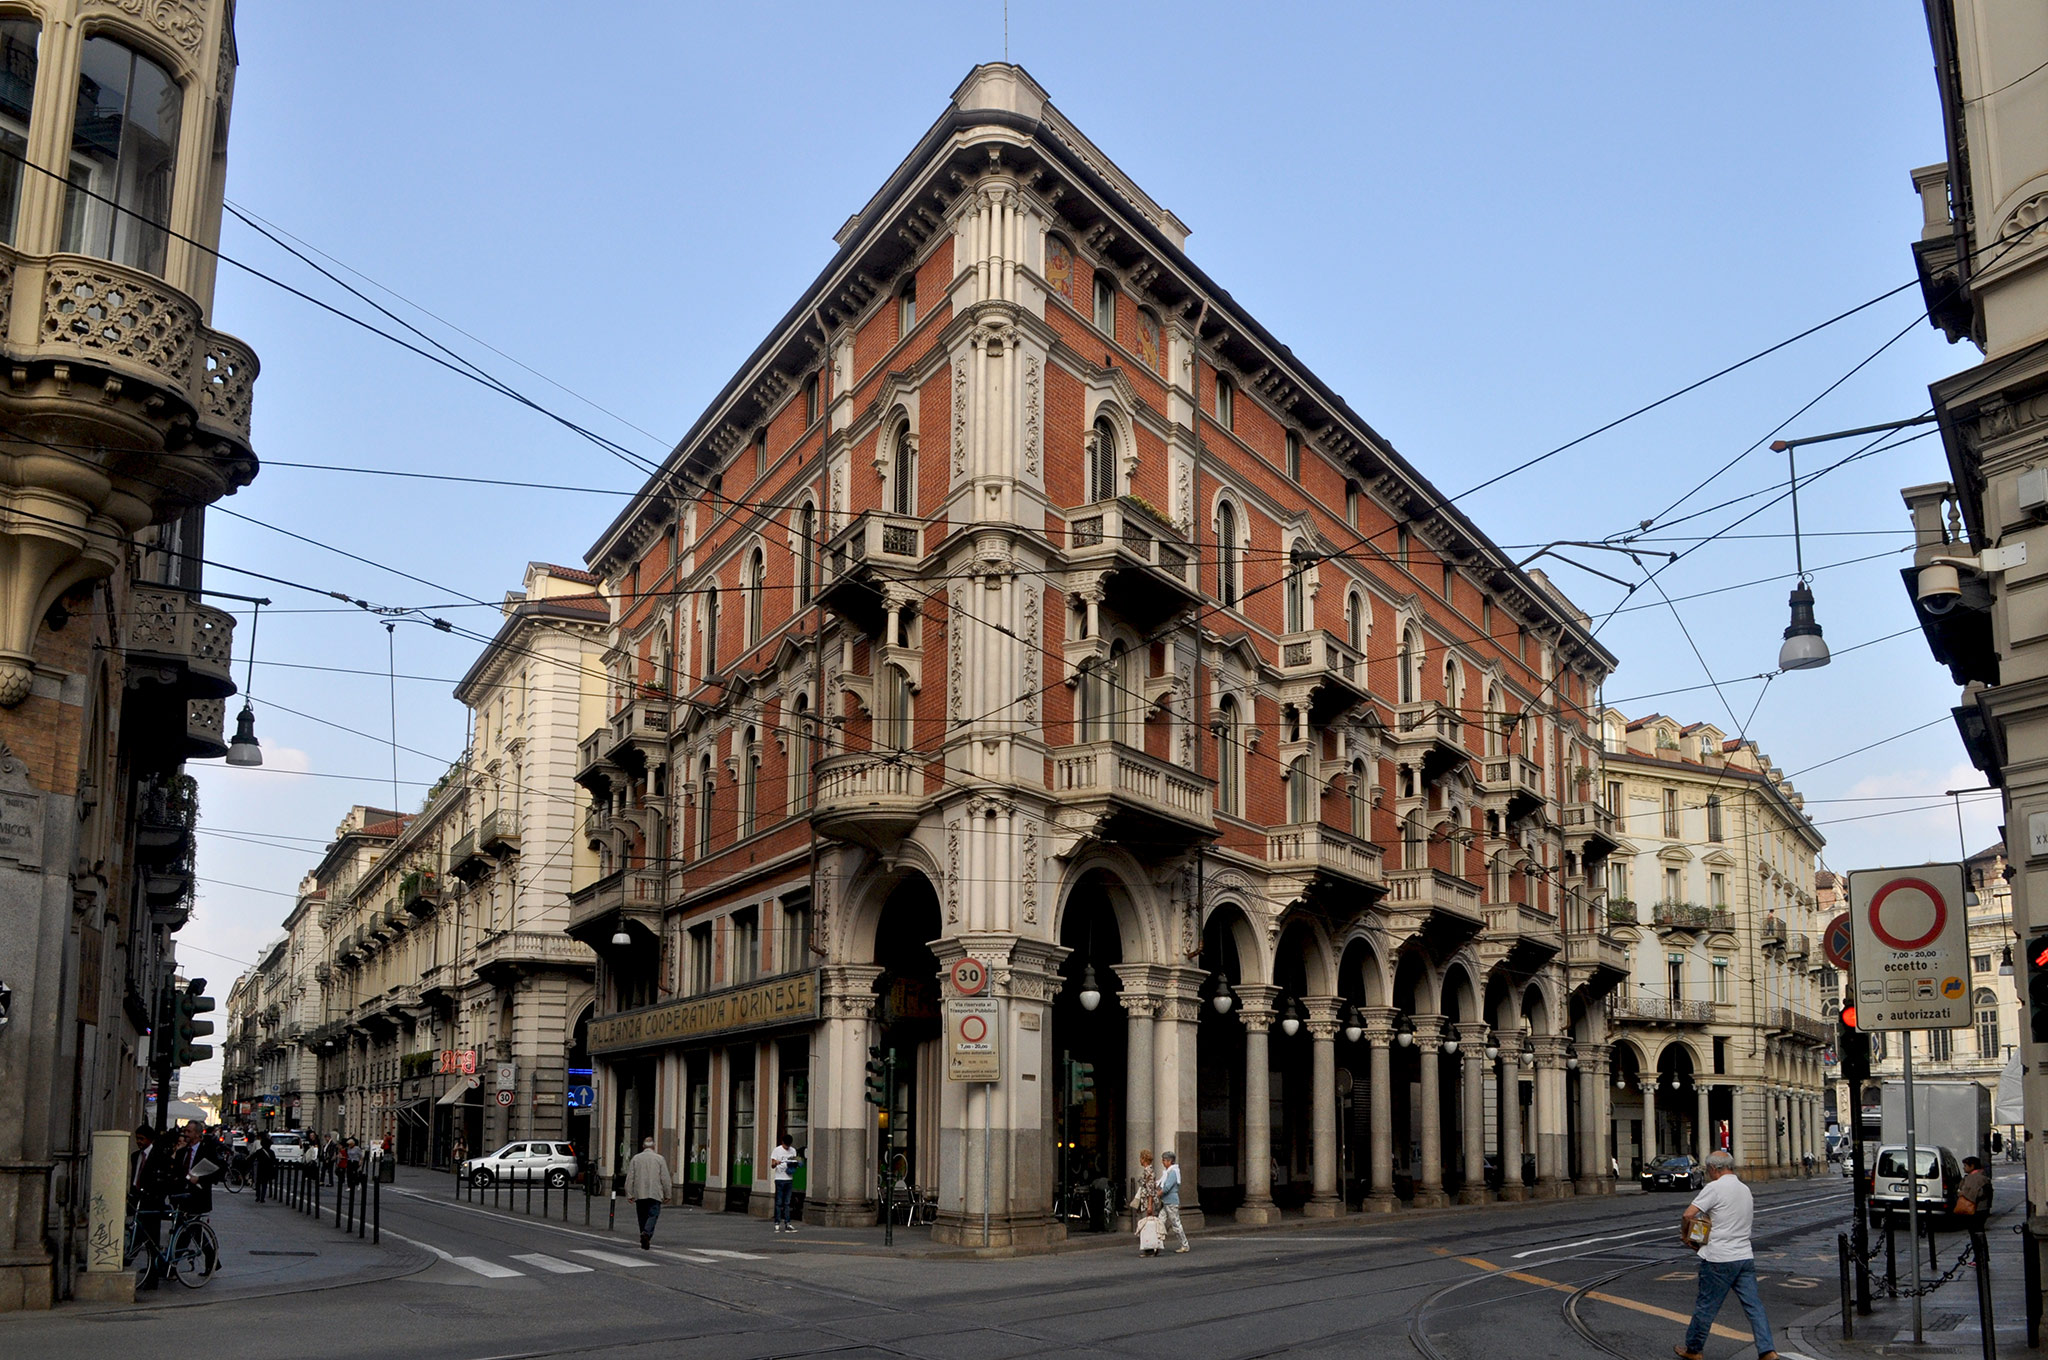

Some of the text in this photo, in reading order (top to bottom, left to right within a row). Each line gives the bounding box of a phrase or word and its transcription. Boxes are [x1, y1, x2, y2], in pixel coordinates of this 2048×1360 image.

[1884, 961, 1928, 972] eccetto
[958, 969, 979, 981] 30
[592, 982, 807, 1043] ALLEANZA COOPERATIVA TORINESE
[1890, 1008, 1951, 1020] autorizzati
[500, 1093, 510, 1102] 30
[1656, 1271, 1823, 1289] BS
